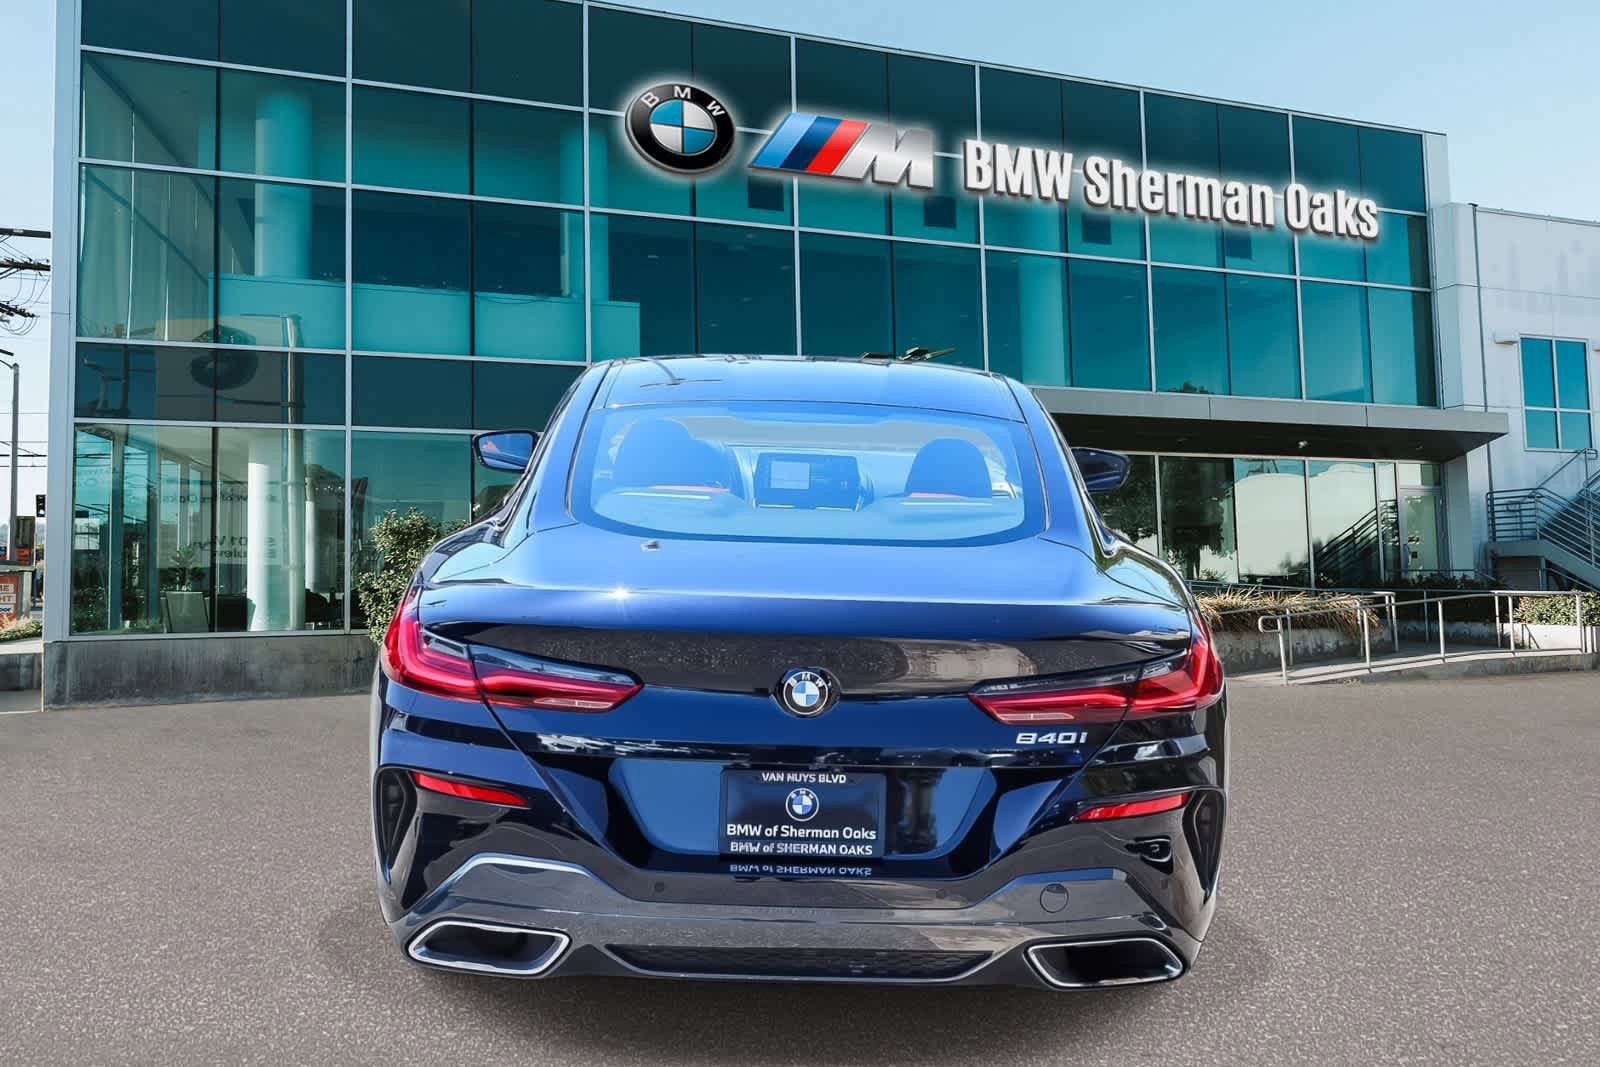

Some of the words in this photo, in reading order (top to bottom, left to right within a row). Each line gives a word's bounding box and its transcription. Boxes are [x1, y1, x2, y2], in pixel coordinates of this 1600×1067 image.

[641, 85, 726, 117] BMW
[964, 139, 1073, 201] BMW
[1083, 156, 1275, 227] Sherman
[1284, 183, 1379, 240] Oaks
[762, 772, 784, 782] VAN
[786, 773, 816, 783] NUYS
[818, 774, 847, 784] BLVD
[727, 824, 762, 836] BMW
[764, 825, 779, 837] of
[780, 826, 839, 839] Sherman
[842, 827, 876, 840] Oaks
[730, 841, 760, 852] BMW
[763, 843, 775, 853] of
[776, 843, 836, 855] SHERMAN
[839, 844, 873, 855] OAKS
